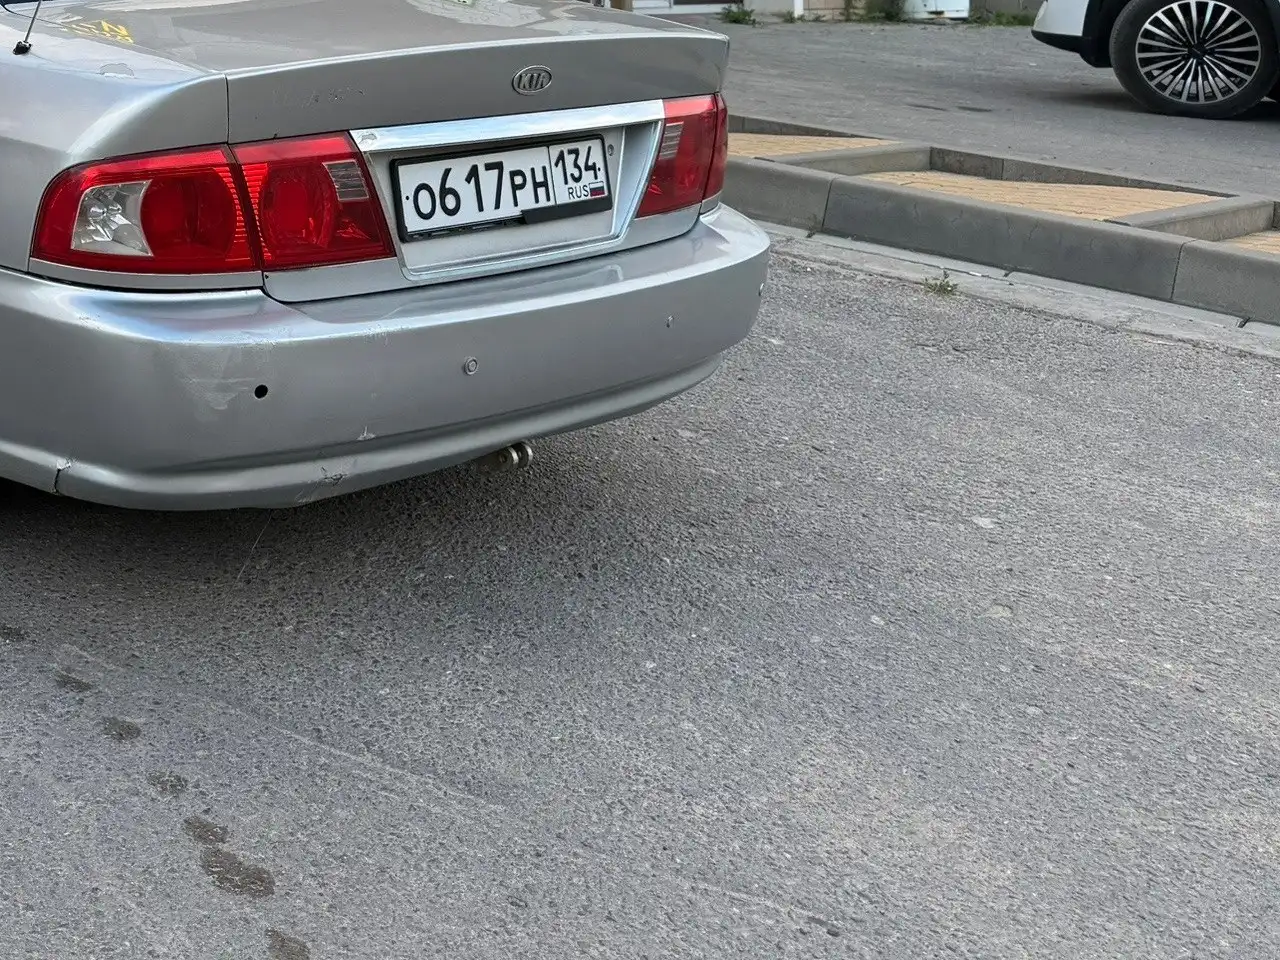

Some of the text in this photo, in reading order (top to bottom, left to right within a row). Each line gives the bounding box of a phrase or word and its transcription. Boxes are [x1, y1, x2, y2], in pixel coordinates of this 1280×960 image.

[517, 71, 547, 89] KIA
[554, 145, 598, 186] 134
[567, 185, 590, 201] RUS
